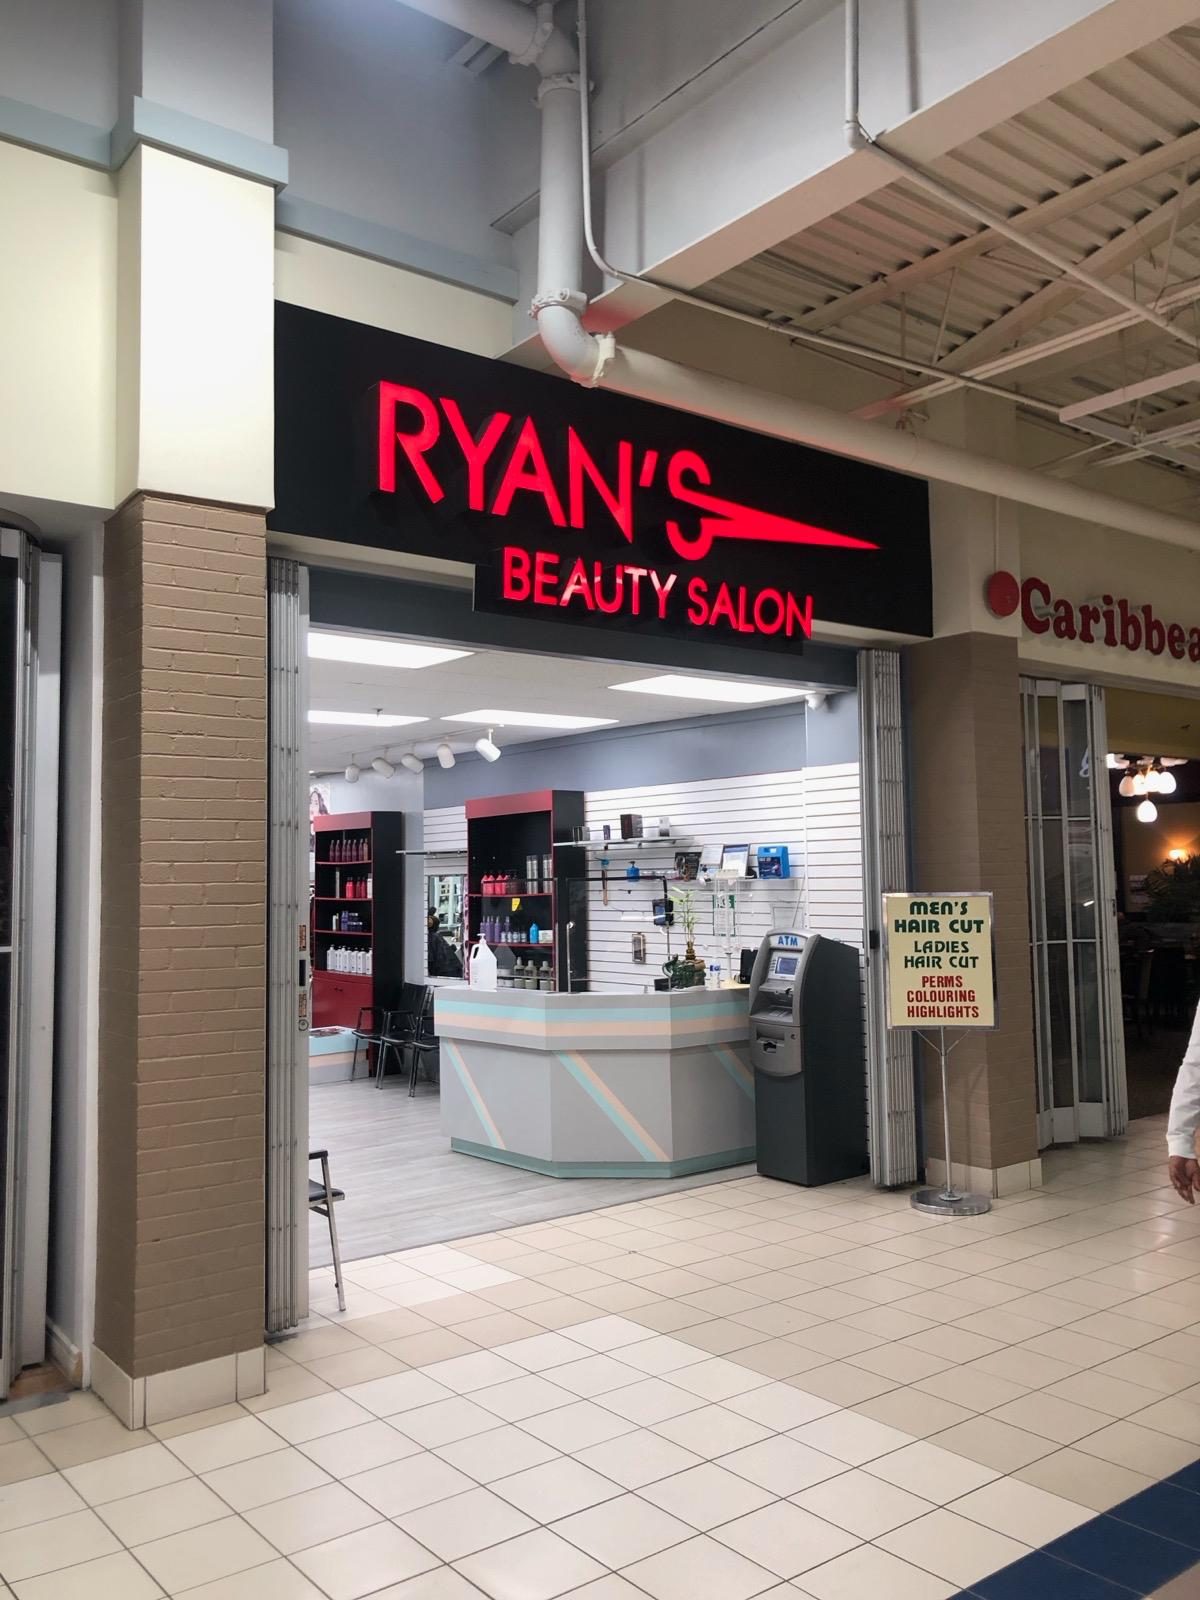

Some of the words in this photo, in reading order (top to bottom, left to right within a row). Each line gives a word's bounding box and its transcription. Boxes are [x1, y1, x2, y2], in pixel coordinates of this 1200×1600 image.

[378, 380, 881, 561] RYAN'S
[503, 546, 678, 619] BEAUTY
[687, 576, 813, 640] SALON
[909, 901, 968, 915] MEN'S
[894, 919, 940, 933] HAIR
[949, 919, 984, 933] CUT
[778, 936, 798, 946] ATM
[914, 941, 969, 954] LADIES
[904, 956, 942, 969] HAIR
[949, 956, 979, 968] CUT
[922, 975, 963, 988] PERMS
[907, 990, 976, 1003] COLOURING
[907, 1005, 979, 1018] HIGHLIGHTS
